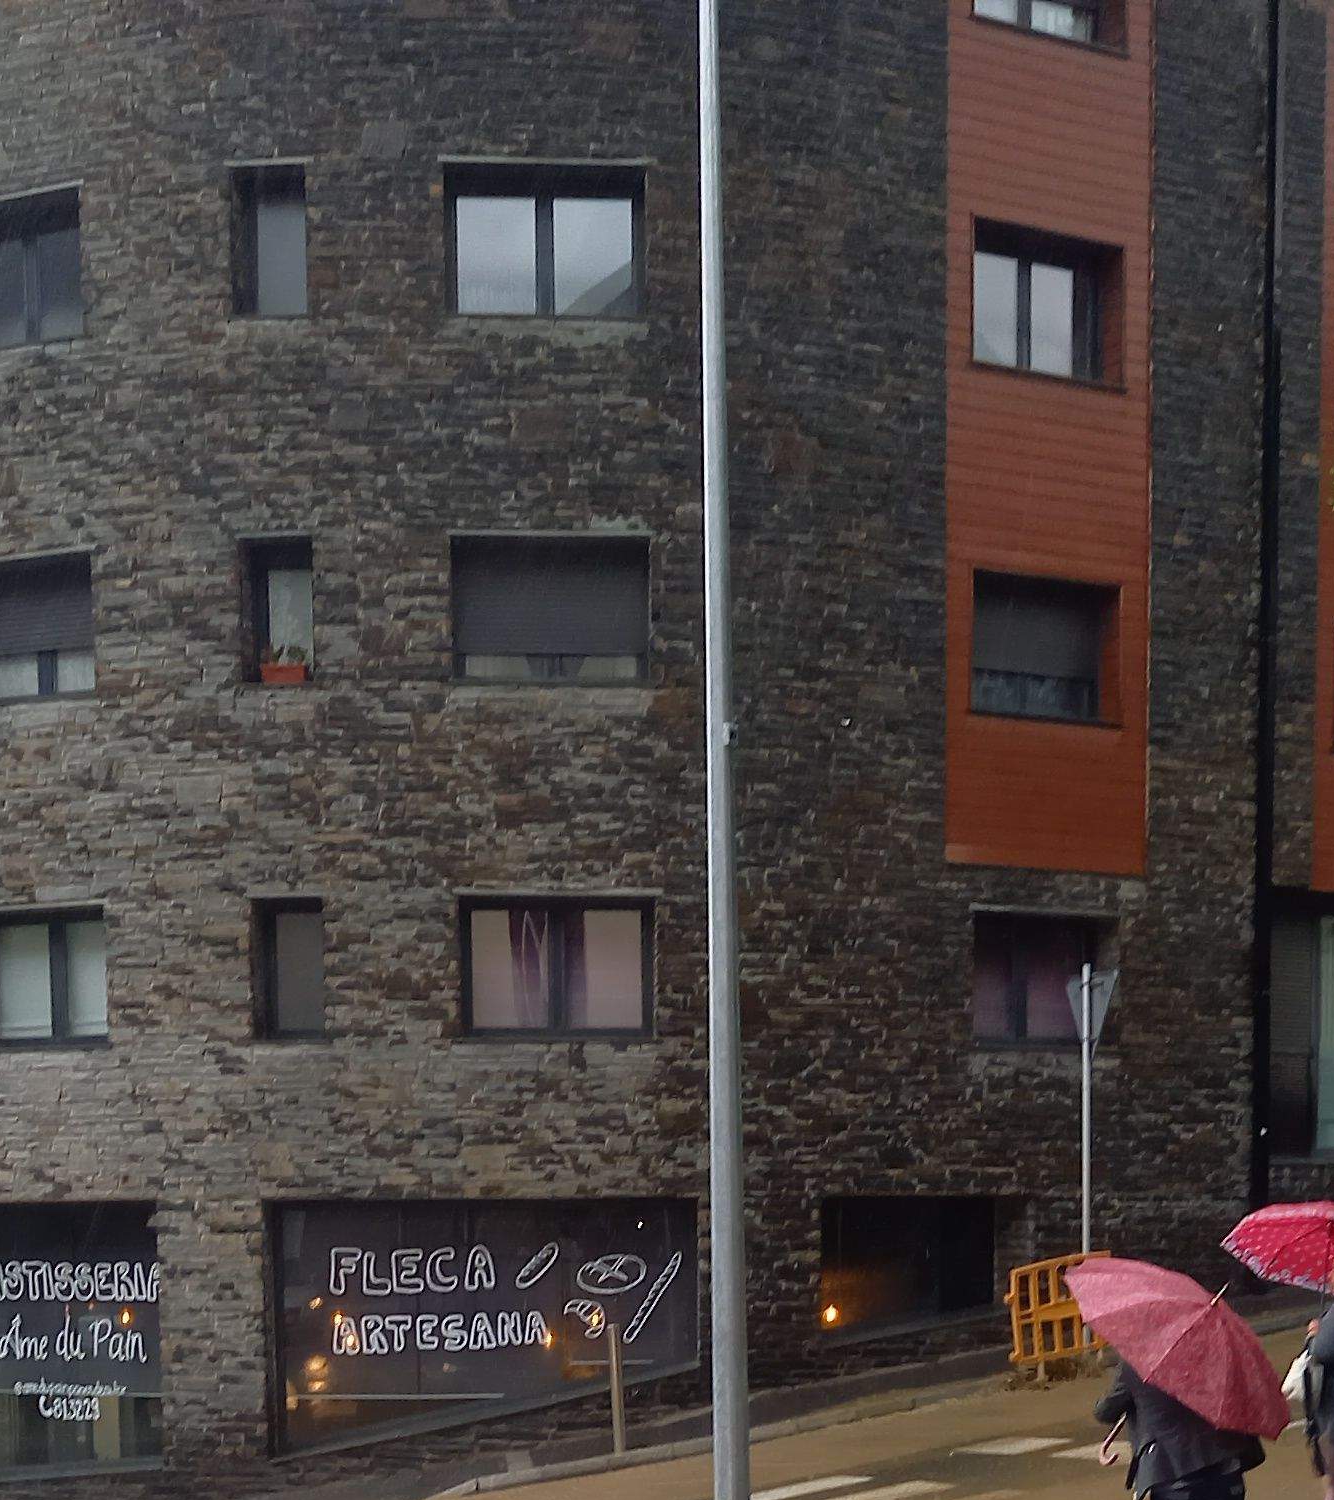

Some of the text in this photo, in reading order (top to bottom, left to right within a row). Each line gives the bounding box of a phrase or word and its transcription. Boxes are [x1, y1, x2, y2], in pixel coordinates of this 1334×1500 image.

[328, 1243, 497, 1297] FLECA
[55, 1311, 86, 1362] du
[88, 1317, 148, 1364] Pain
[331, 1310, 549, 1355] ARTESANA
